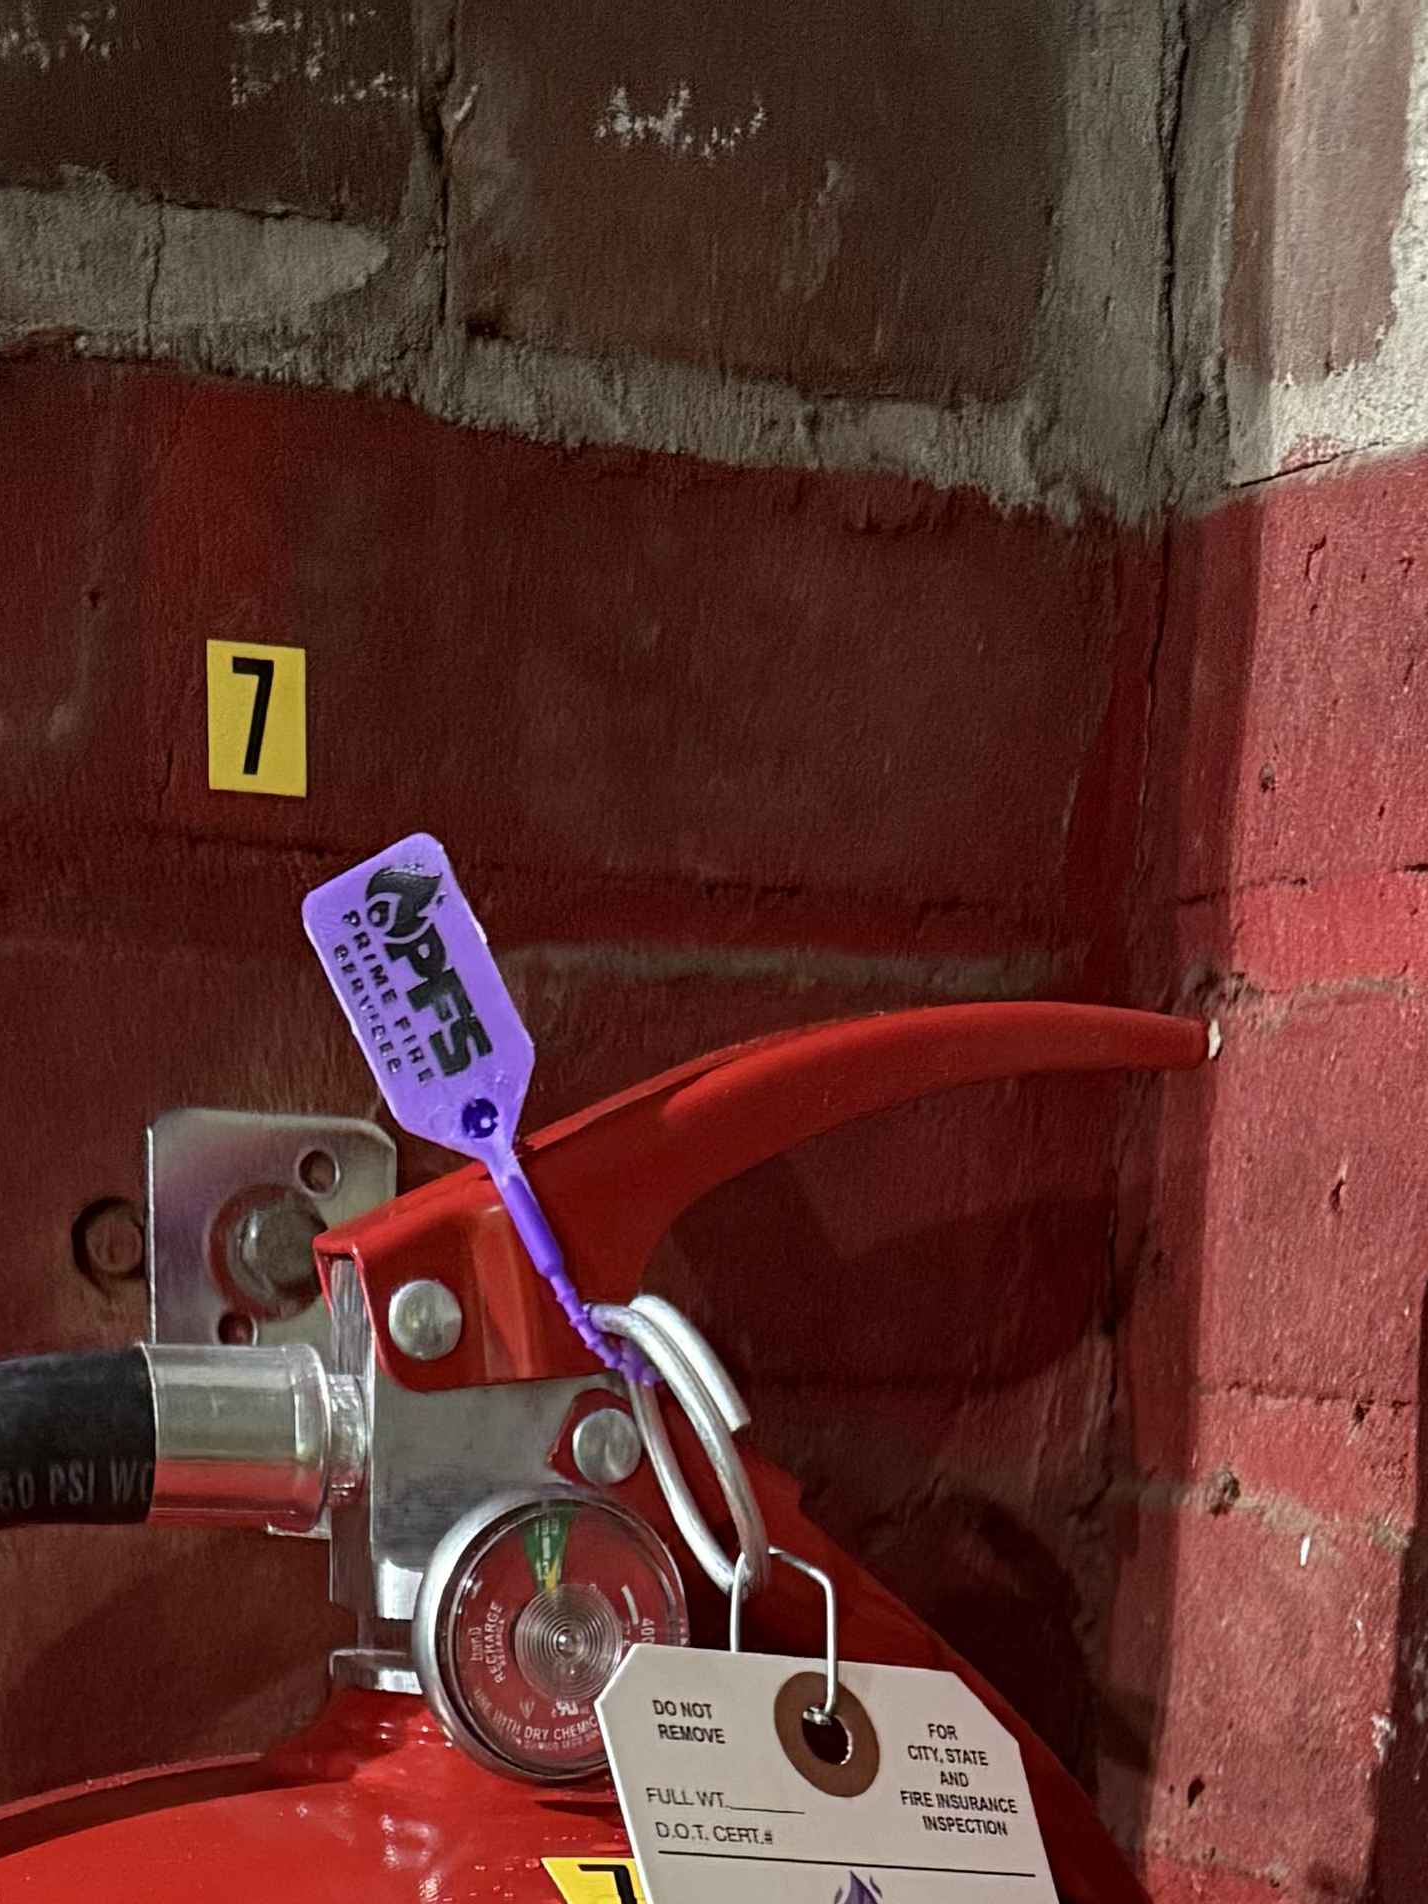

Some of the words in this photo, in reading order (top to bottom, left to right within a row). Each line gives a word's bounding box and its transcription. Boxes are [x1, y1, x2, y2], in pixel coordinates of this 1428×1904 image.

[232, 656, 274, 775] 7
[342, 908, 399, 1009] PRIME
[394, 1016, 435, 1085] FIRE
[385, 929, 493, 1077] PFS
[50, 1463, 95, 1505] PSI
[653, 1699, 675, 1717] DO
[680, 1701, 712, 1720] NOT
[553, 1715, 598, 1740] CHEMIC
[658, 1724, 725, 1744] REMOVE
[928, 1723, 958, 1741] FOR
[945, 1747, 989, 1767] STATE
[939, 1769, 969, 1788] AND
[646, 1788, 694, 1806] FULL
[900, 1790, 933, 1808] FIRE
[936, 1792, 1018, 1814] INSURANCE
[655, 1822, 709, 1842] D.O.T.
[922, 1814, 1008, 1836] INSPECTION
